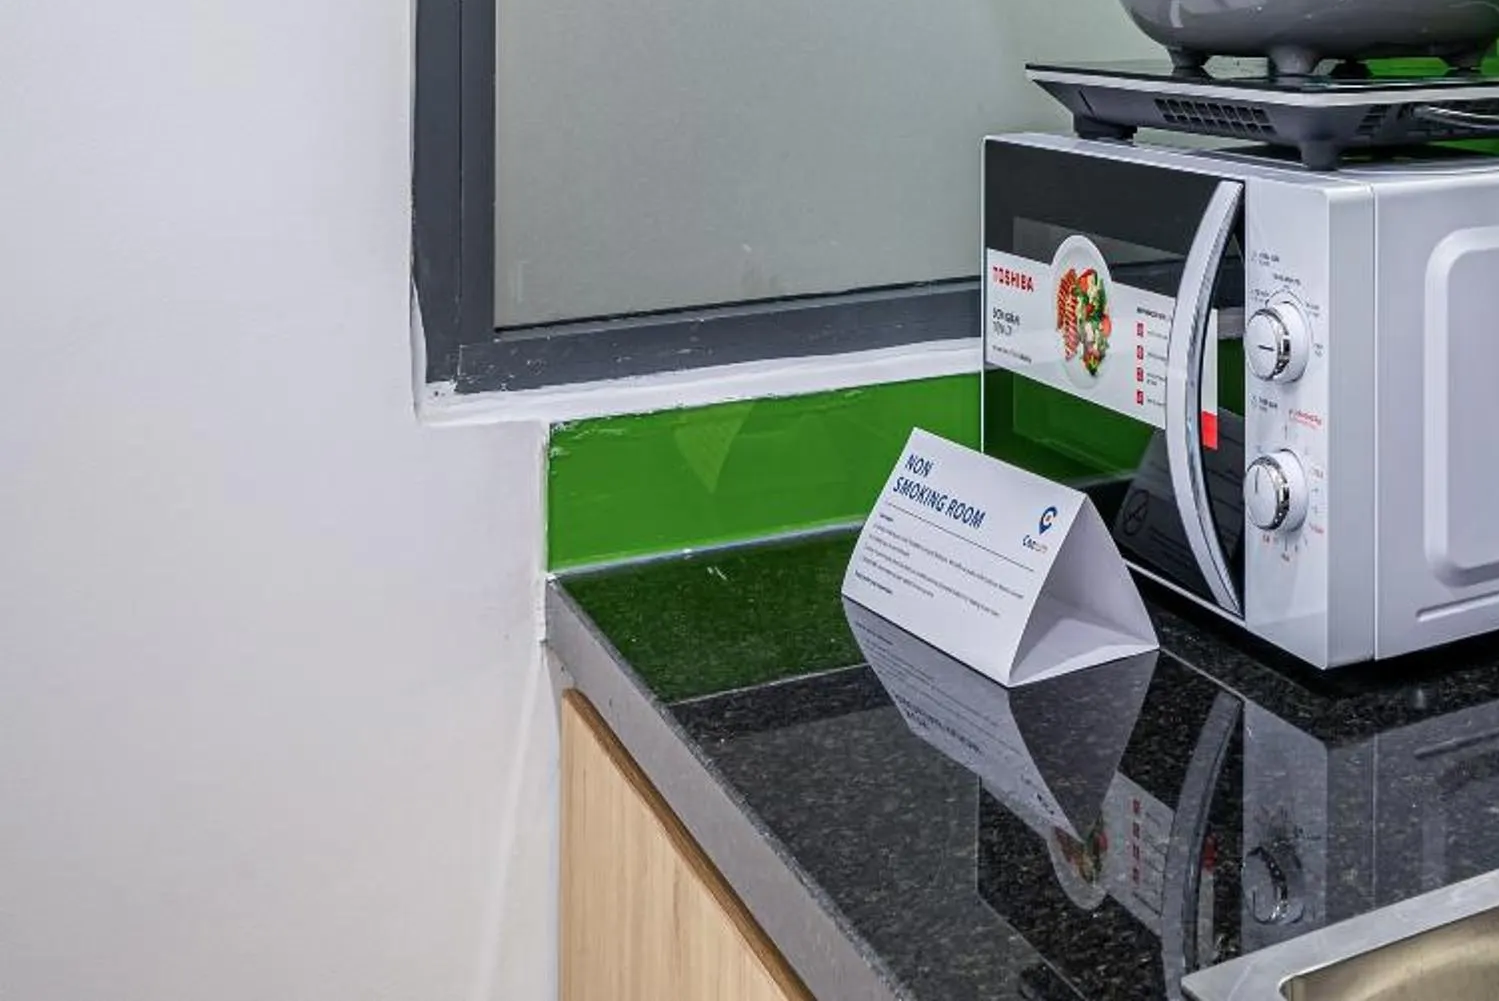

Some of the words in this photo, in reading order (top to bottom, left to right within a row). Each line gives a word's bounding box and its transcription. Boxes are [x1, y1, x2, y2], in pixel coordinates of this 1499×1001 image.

[992, 265, 1034, 292] TOSHIBA
[904, 453, 933, 478] NON
[892, 476, 948, 513] SMOKING
[944, 498, 987, 530] ROOM
